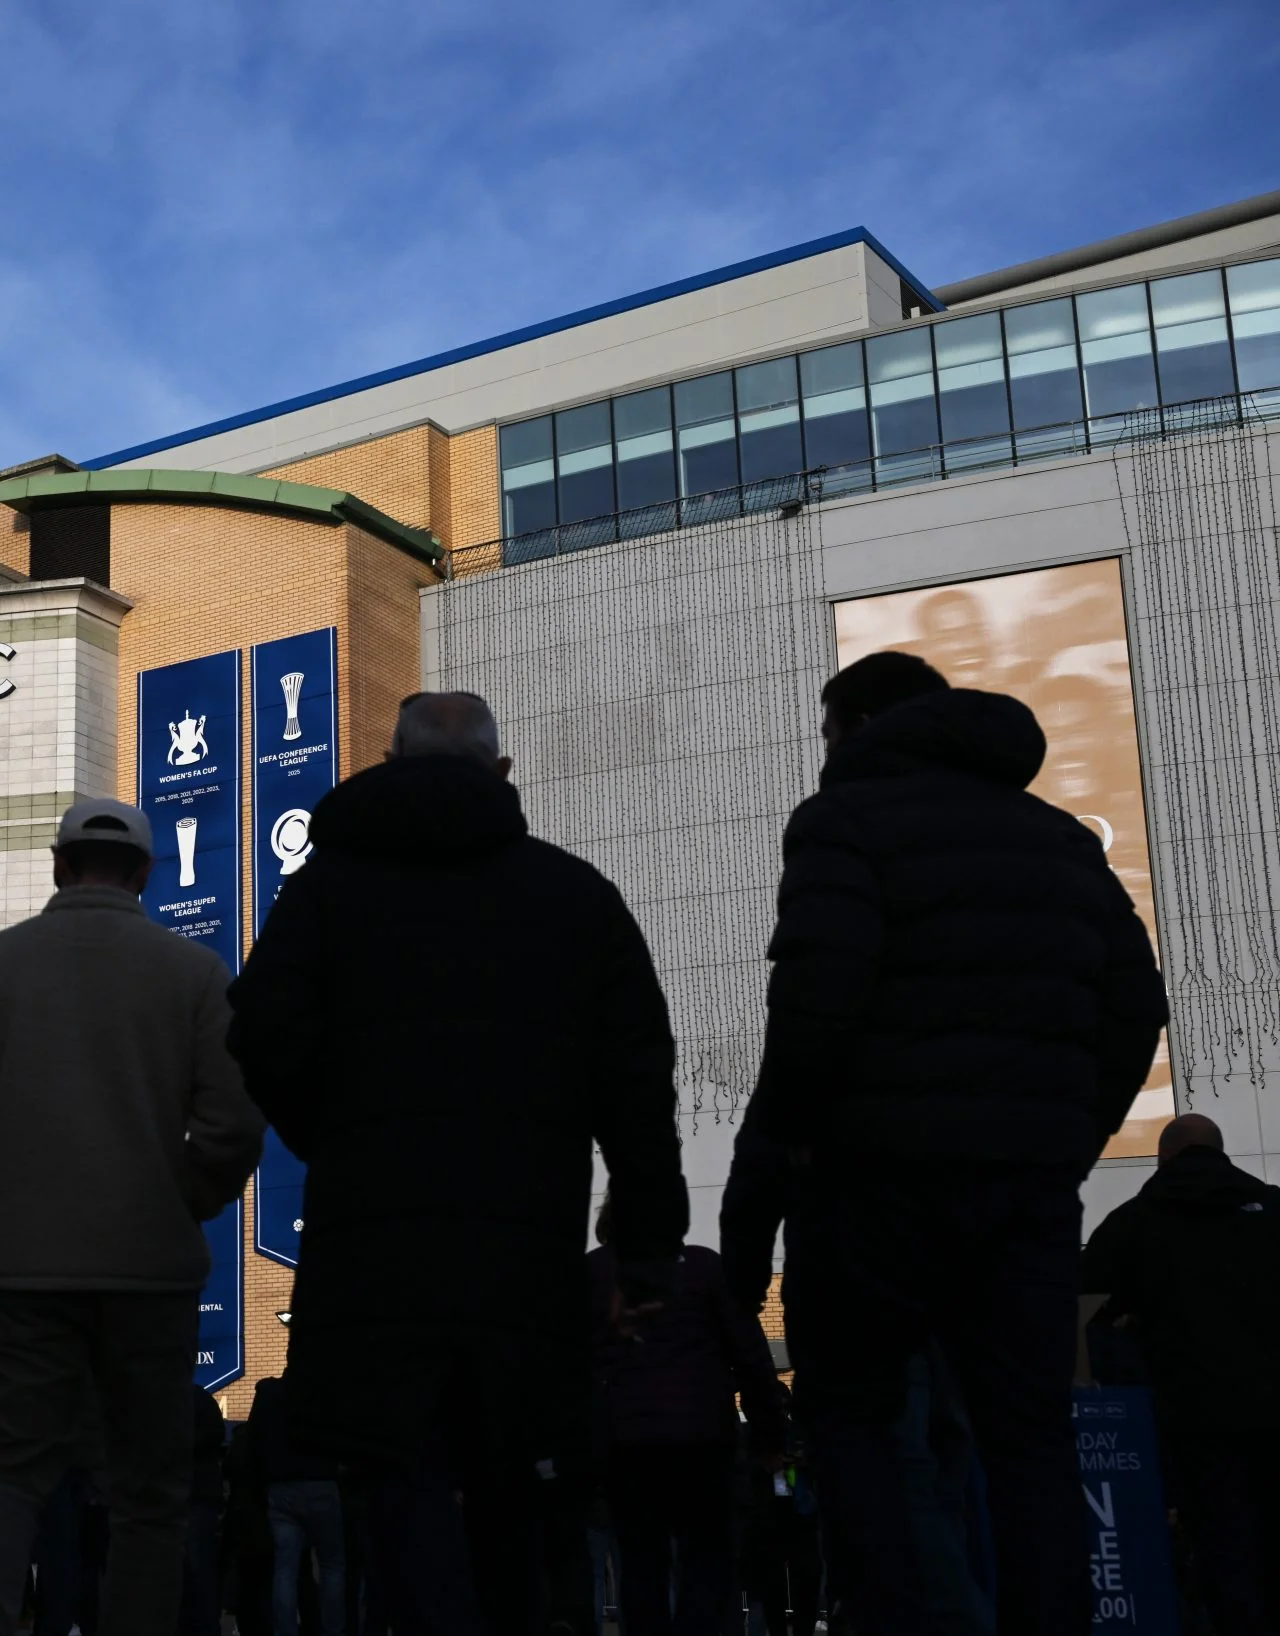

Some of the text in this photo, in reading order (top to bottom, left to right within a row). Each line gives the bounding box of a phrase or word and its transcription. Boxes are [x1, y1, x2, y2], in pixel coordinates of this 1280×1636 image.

[259, 743, 328, 764] UEFA CONFERENCE
[280, 755, 308, 767] LEAGUE
[159, 766, 218, 784] WOMEN'S FA CUP
[287, 768, 300, 777] 2025
[159, 896, 216, 912] WOMEN'S SUPER
[174, 906, 202, 917] LEAGUE
[195, 1351, 215, 1365] DN
[1075, 1431, 1119, 1451] DAY
[1079, 1452, 1142, 1472] MMES
